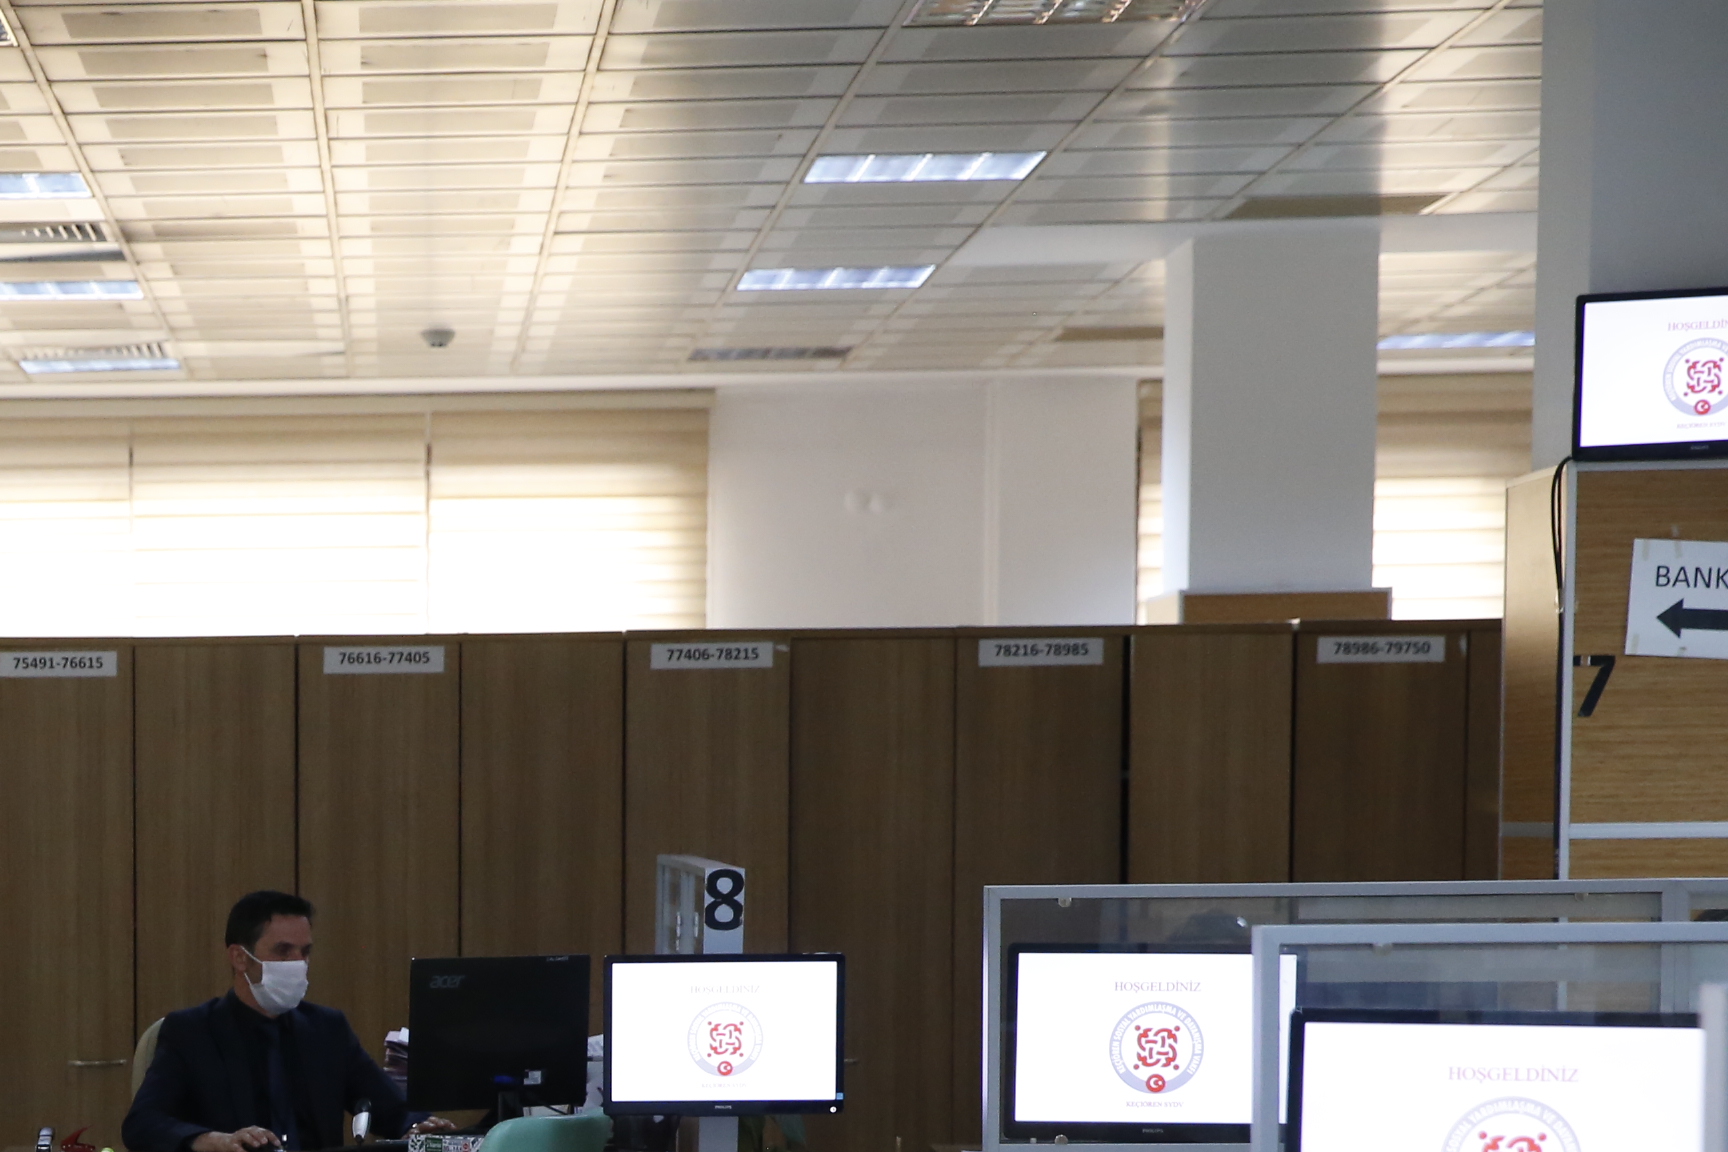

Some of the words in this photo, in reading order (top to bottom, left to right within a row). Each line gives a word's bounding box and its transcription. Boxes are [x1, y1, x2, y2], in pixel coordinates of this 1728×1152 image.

[1667, 318, 1728, 331] HOŞGELDİ
[666, 648, 760, 661] 77406-78215
[995, 643, 1090, 656] 78216-78985
[1334, 641, 1431, 655] 78986-79750
[13, 656, 104, 669] 75491-76615
[339, 651, 431, 664] 76616-77405
[1573, 654, 1617, 718] 7
[703, 869, 745, 931] 8
[429, 974, 466, 988] acer
[1114, 980, 1202, 993] HOŞGELDİNİZ
[1177, 1009, 1187, 1021] VE
[1448, 1064, 1579, 1084] HOŞGELDİNİZ
[1542, 1109, 1556, 1124] VE
